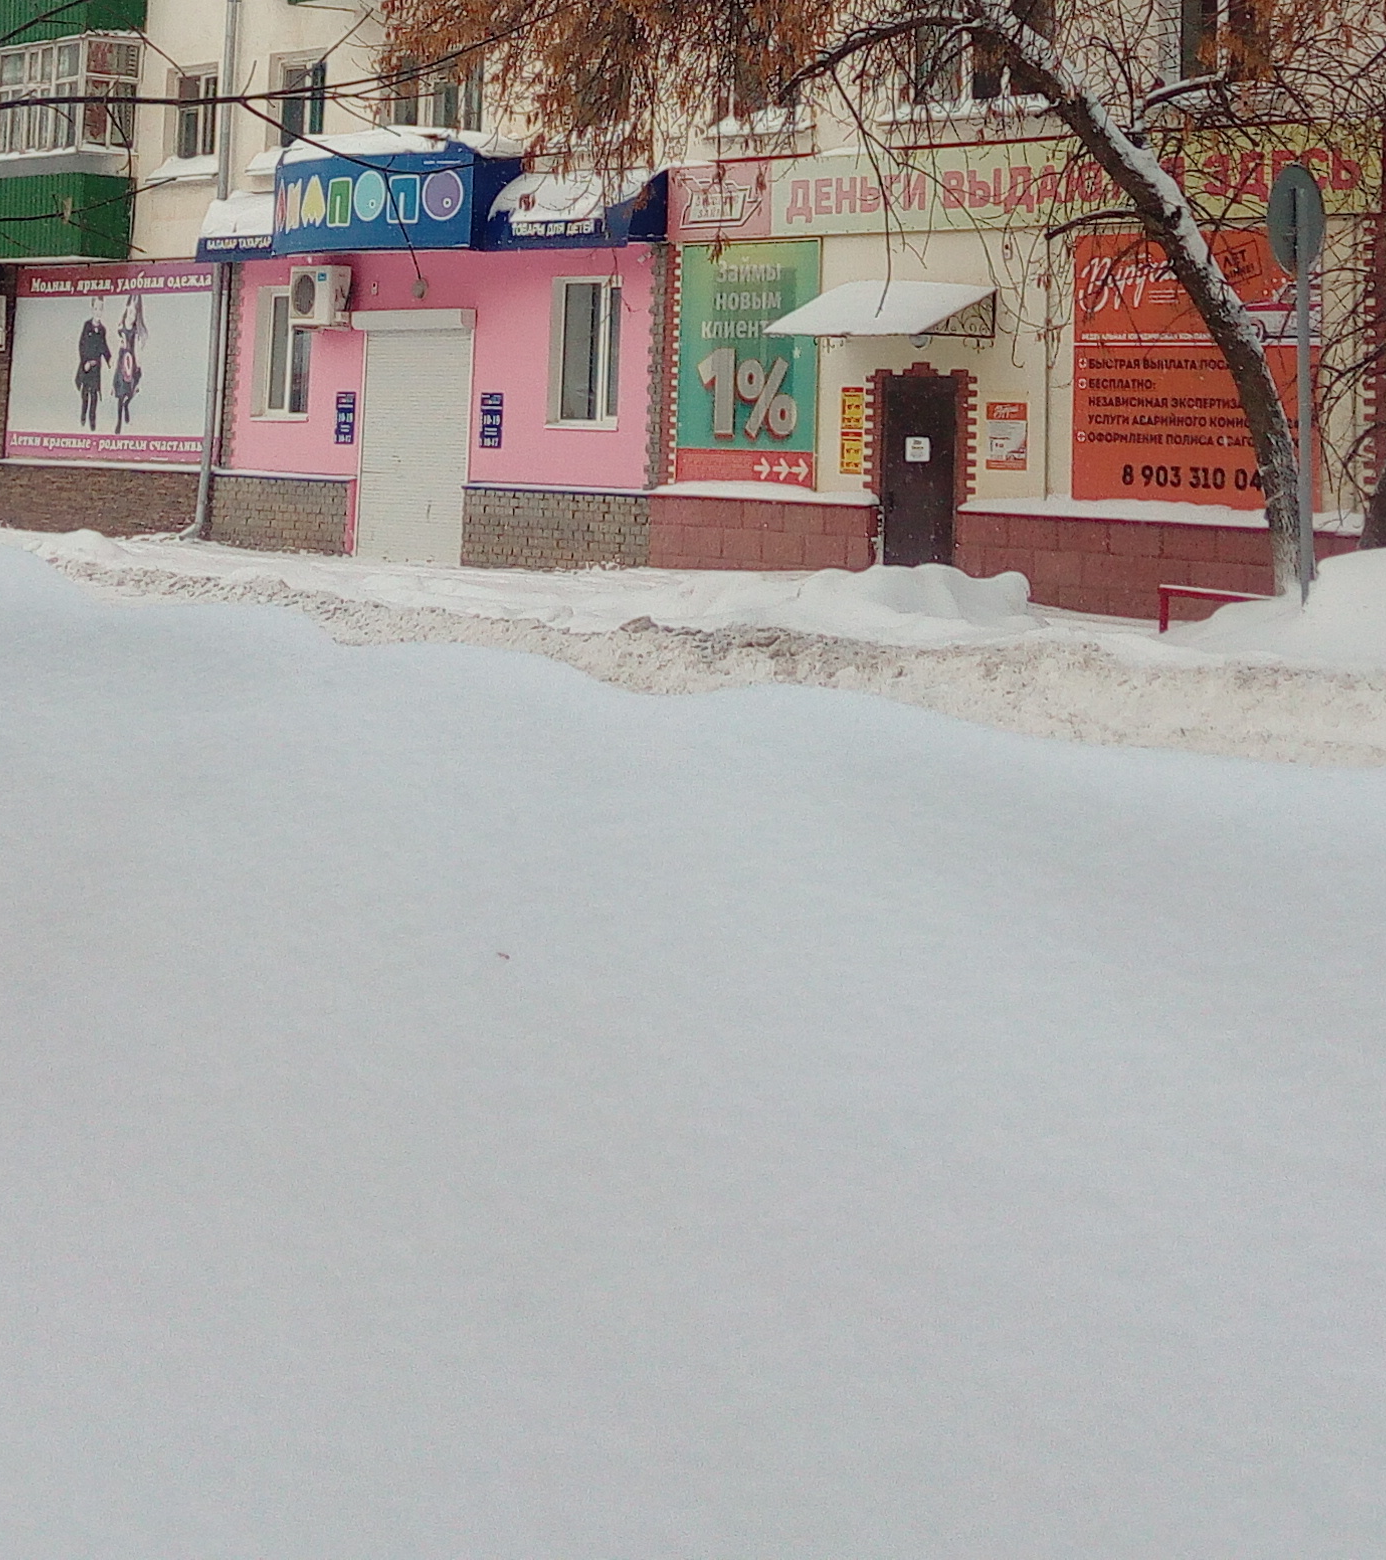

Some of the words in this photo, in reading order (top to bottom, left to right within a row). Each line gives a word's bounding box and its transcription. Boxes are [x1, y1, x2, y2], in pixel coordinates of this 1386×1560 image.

[786, 174, 926, 224] ДЕНЬГИ
[942, 157, 1185, 215] ВЫДАЮЯ
[715, 256, 781, 284] Займы
[31, 277, 74, 294] Модная,
[77, 279, 113, 293] яркая,
[117, 271, 163, 293] удобная
[167, 274, 212, 289] одежда
[715, 290, 781, 311] новым
[701, 319, 785, 339] клиент
[1089, 358, 1140, 370] БЫСТРАЯ
[1143, 359, 1197, 370] ВЫПЛАТА
[1089, 378, 1156, 390] БЕСПЛАТНО:
[1088, 397, 1168, 408] НЕЗАВИСИМАЯ
[1088, 414, 1129, 425] УСЛУГИ
[1132, 413, 1206, 427] АВАРИЙНОГО
[10, 434, 40, 446] Детки
[43, 436, 91, 449] красивые
[98, 439, 146, 451] родители
[1088, 431, 1163, 445] ОФОРМЛЕНИЕ
[1166, 434, 1213, 446] ПОЛИСА
[1121, 464, 1134, 486] 8
[1141, 465, 1181, 487] 903
[1189, 466, 1225, 489] 310
